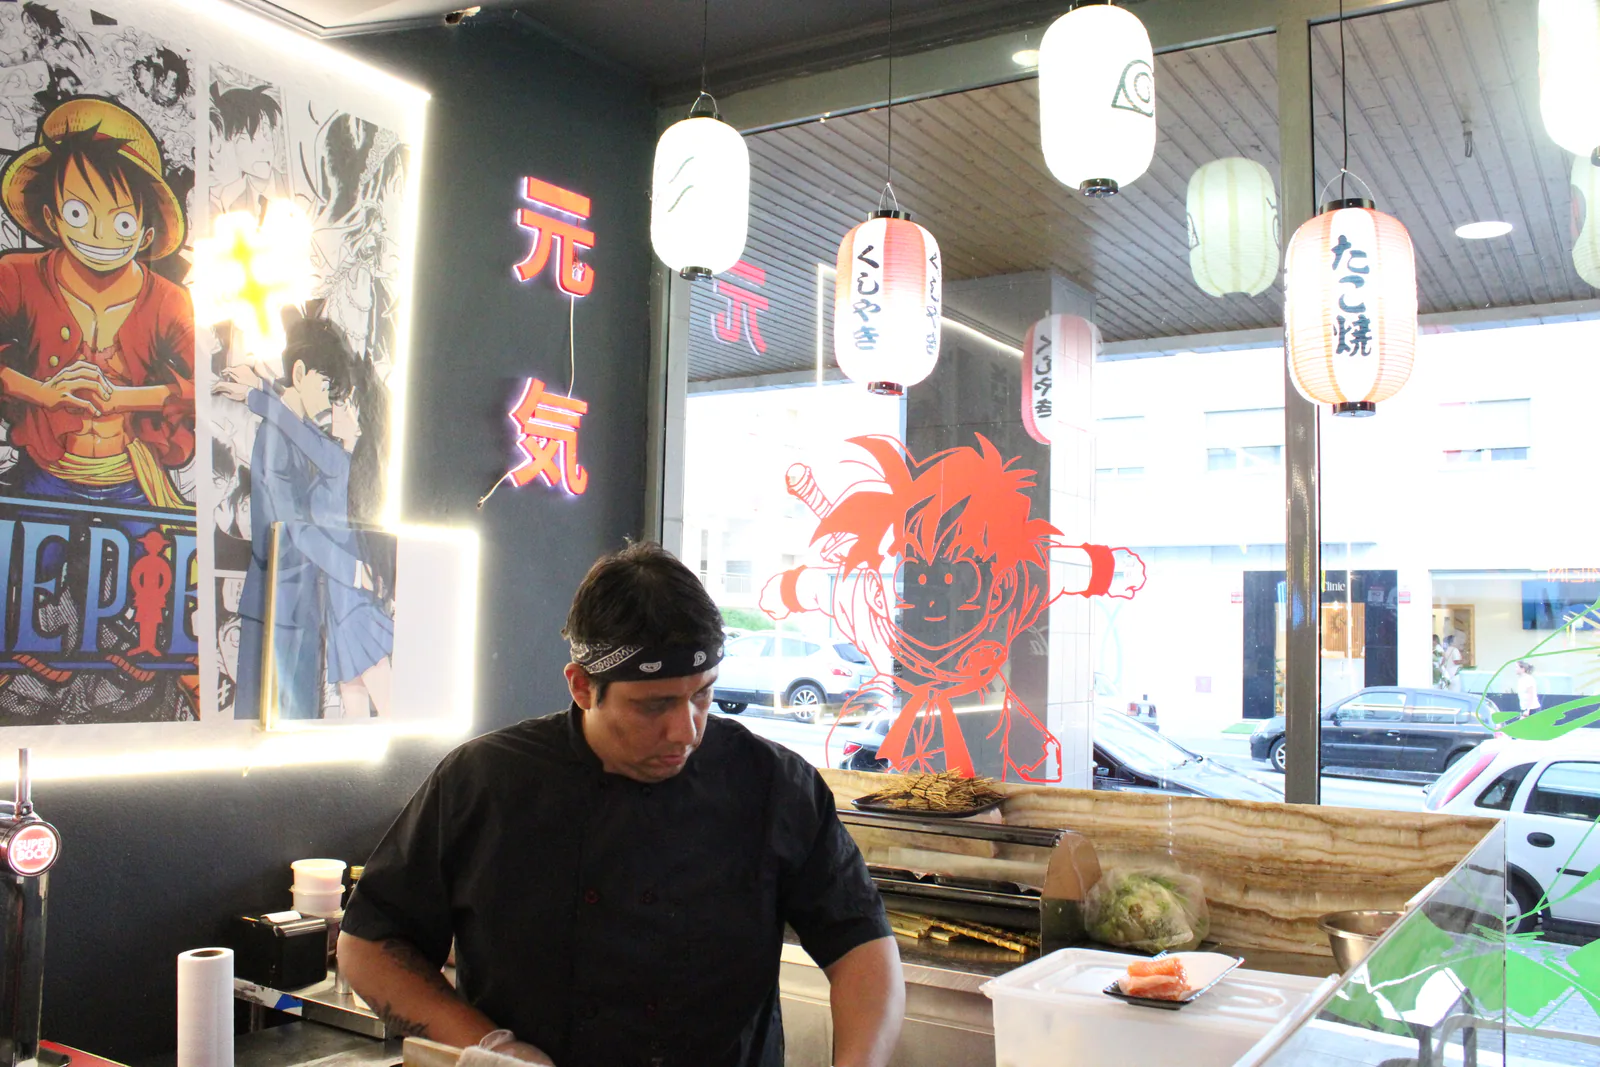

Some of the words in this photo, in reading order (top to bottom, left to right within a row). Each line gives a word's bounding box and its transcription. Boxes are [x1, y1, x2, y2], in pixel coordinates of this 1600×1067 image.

[509, 176, 595, 496] 元気
[852, 244, 882, 350] くしやき
[1330, 234, 1373, 357] たこ焼
[16, 837, 51, 850] SUPER
[16, 848, 49, 861] BOCK
